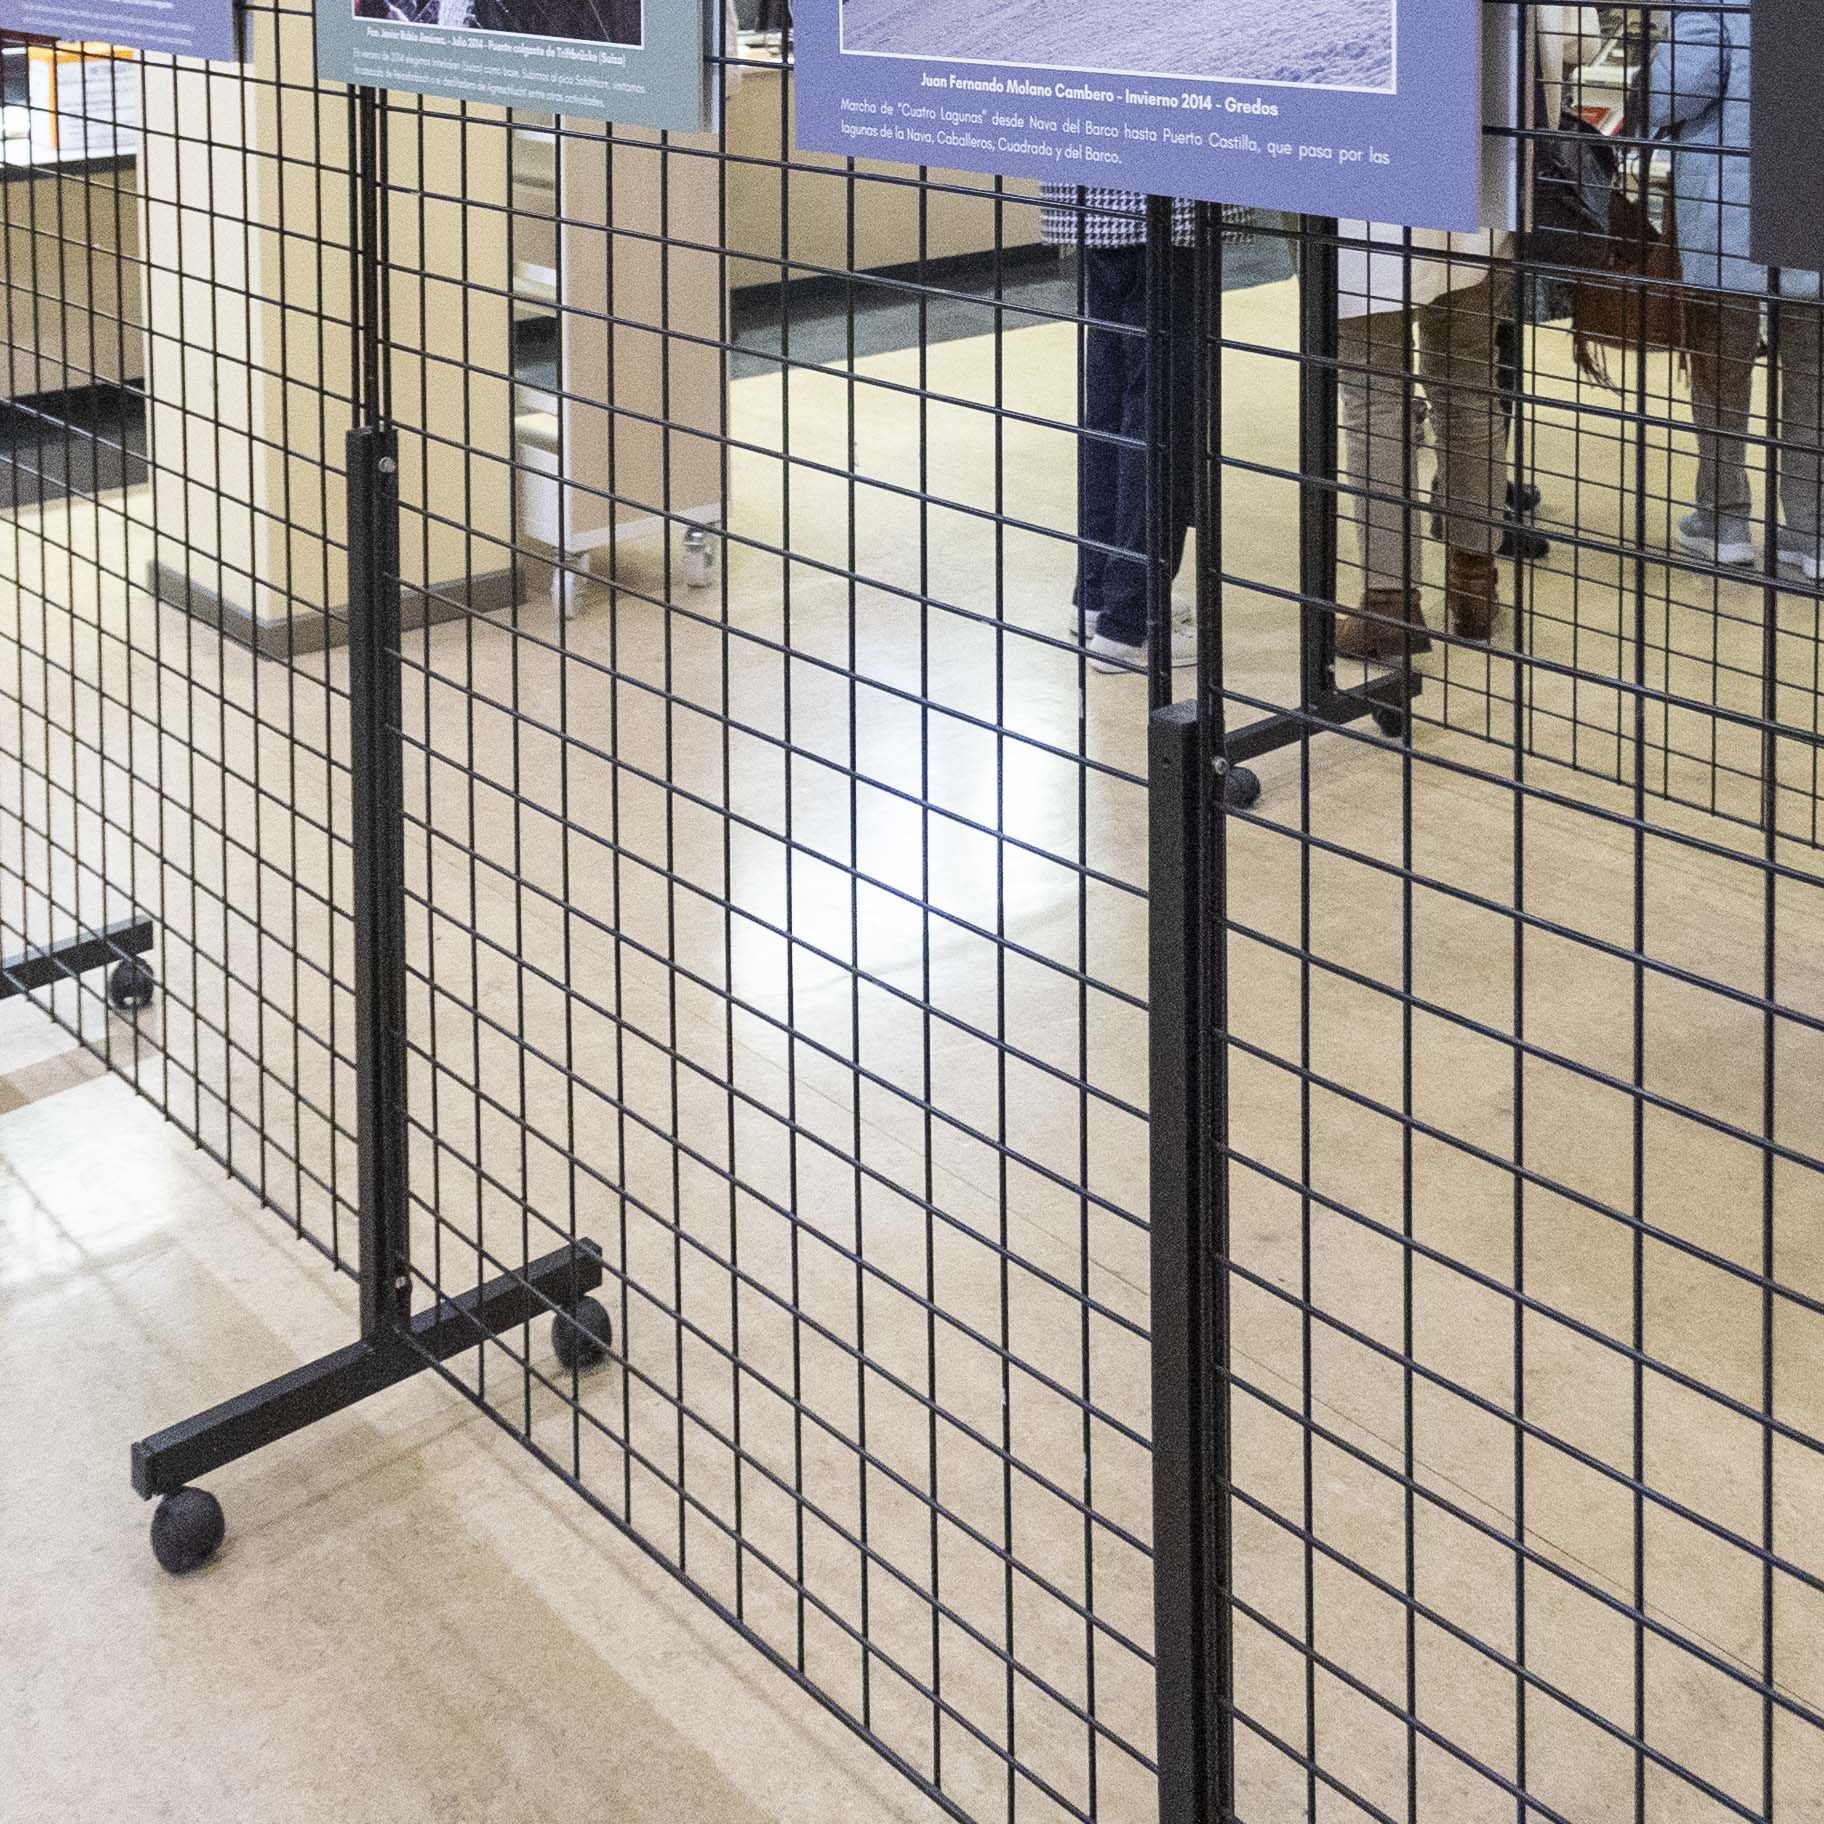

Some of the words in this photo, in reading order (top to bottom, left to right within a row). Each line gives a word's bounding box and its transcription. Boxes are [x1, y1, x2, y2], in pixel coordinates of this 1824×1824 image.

[921, 73, 947, 88] Juan
[949, 74, 1004, 93] Fernando
[1006, 80, 1052, 97] Molano
[1055, 84, 1114, 102] Cambero
[1125, 88, 1179, 108] Invierno
[1181, 93, 1213, 111] 2014
[1224, 97, 1279, 116] Gredos
[840, 98, 876, 113] Marcha
[881, 100, 893, 115] de
[992, 112, 1024, 128] desde
[1029, 115, 1057, 131] Nava
[1062, 116, 1080, 134] del
[1085, 120, 1119, 138] Barco
[1124, 123, 1157, 141] hasta
[1163, 128, 1203, 146] Puerto
[1208, 133, 1261, 153] Castilla,
[1267, 140, 1292, 157] que
[1299, 144, 1332, 162] pasa
[1339, 149, 1362, 165] por
[1369, 146, 1391, 165] las
[840, 120, 878, 138] lagunas
[880, 122, 893, 138] de
[895, 125, 904, 140] la
[907, 128, 935, 144] Nava,
[936, 131, 995, 151] Caballeros,
[997, 137, 1053, 156] Cuadrada
[1055, 146, 1062, 161] y
[1064, 144, 1082, 160] del
[1085, 147, 1122, 164] Barco.
